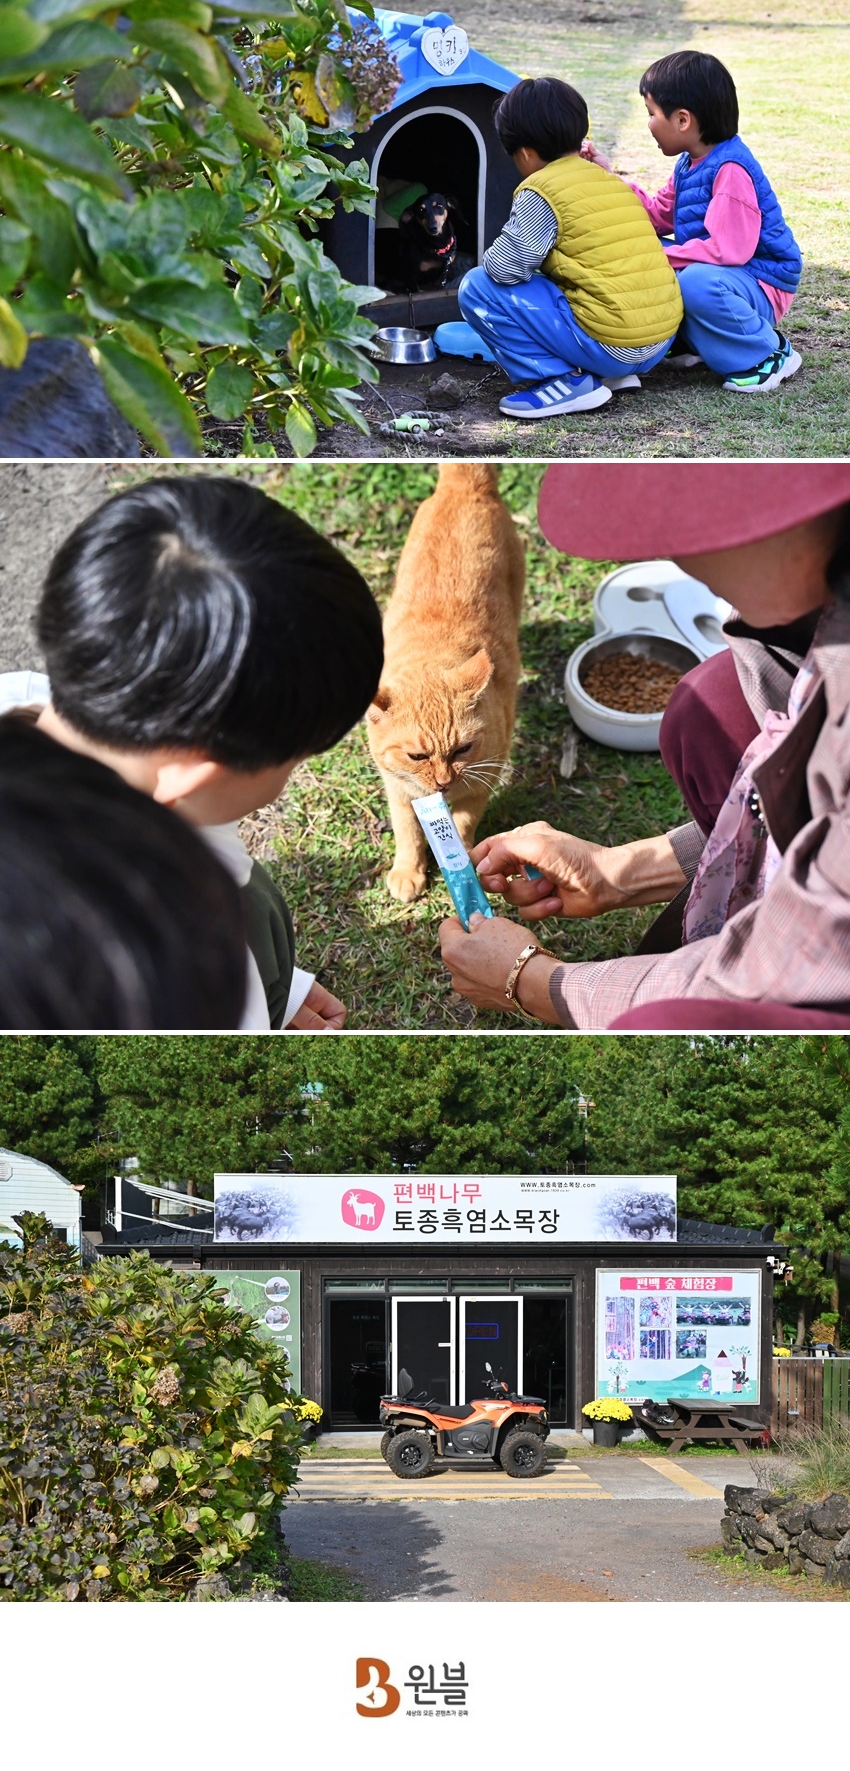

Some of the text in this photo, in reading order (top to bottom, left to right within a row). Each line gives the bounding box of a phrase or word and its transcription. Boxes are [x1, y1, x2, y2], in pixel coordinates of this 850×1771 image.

[393, 1182, 482, 1204] 편백나무
[392, 1208, 560, 1234] 토종흑염소목장
[636, 1277, 717, 1290] 편백 숲 체험장
